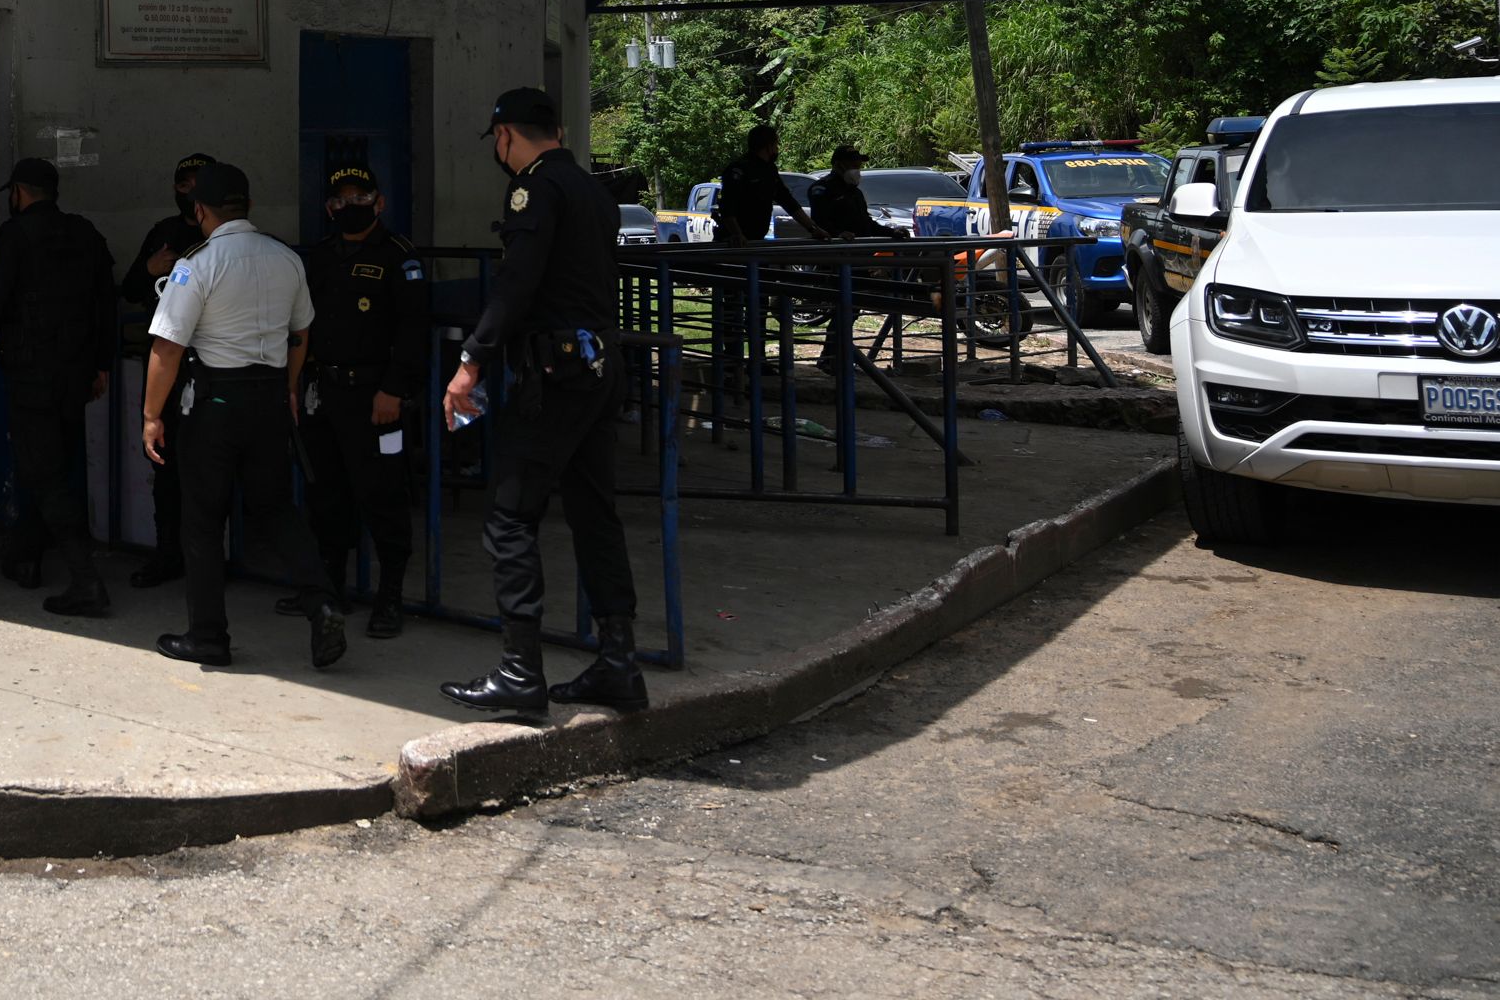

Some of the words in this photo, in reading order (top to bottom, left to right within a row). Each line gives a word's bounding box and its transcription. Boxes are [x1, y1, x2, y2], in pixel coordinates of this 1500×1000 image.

[330, 167, 370, 185] POLICIA
[916, 205, 932, 217] DIFEP
[965, 206, 1040, 240] POCIA
[1423, 413, 1483, 423] Continental
